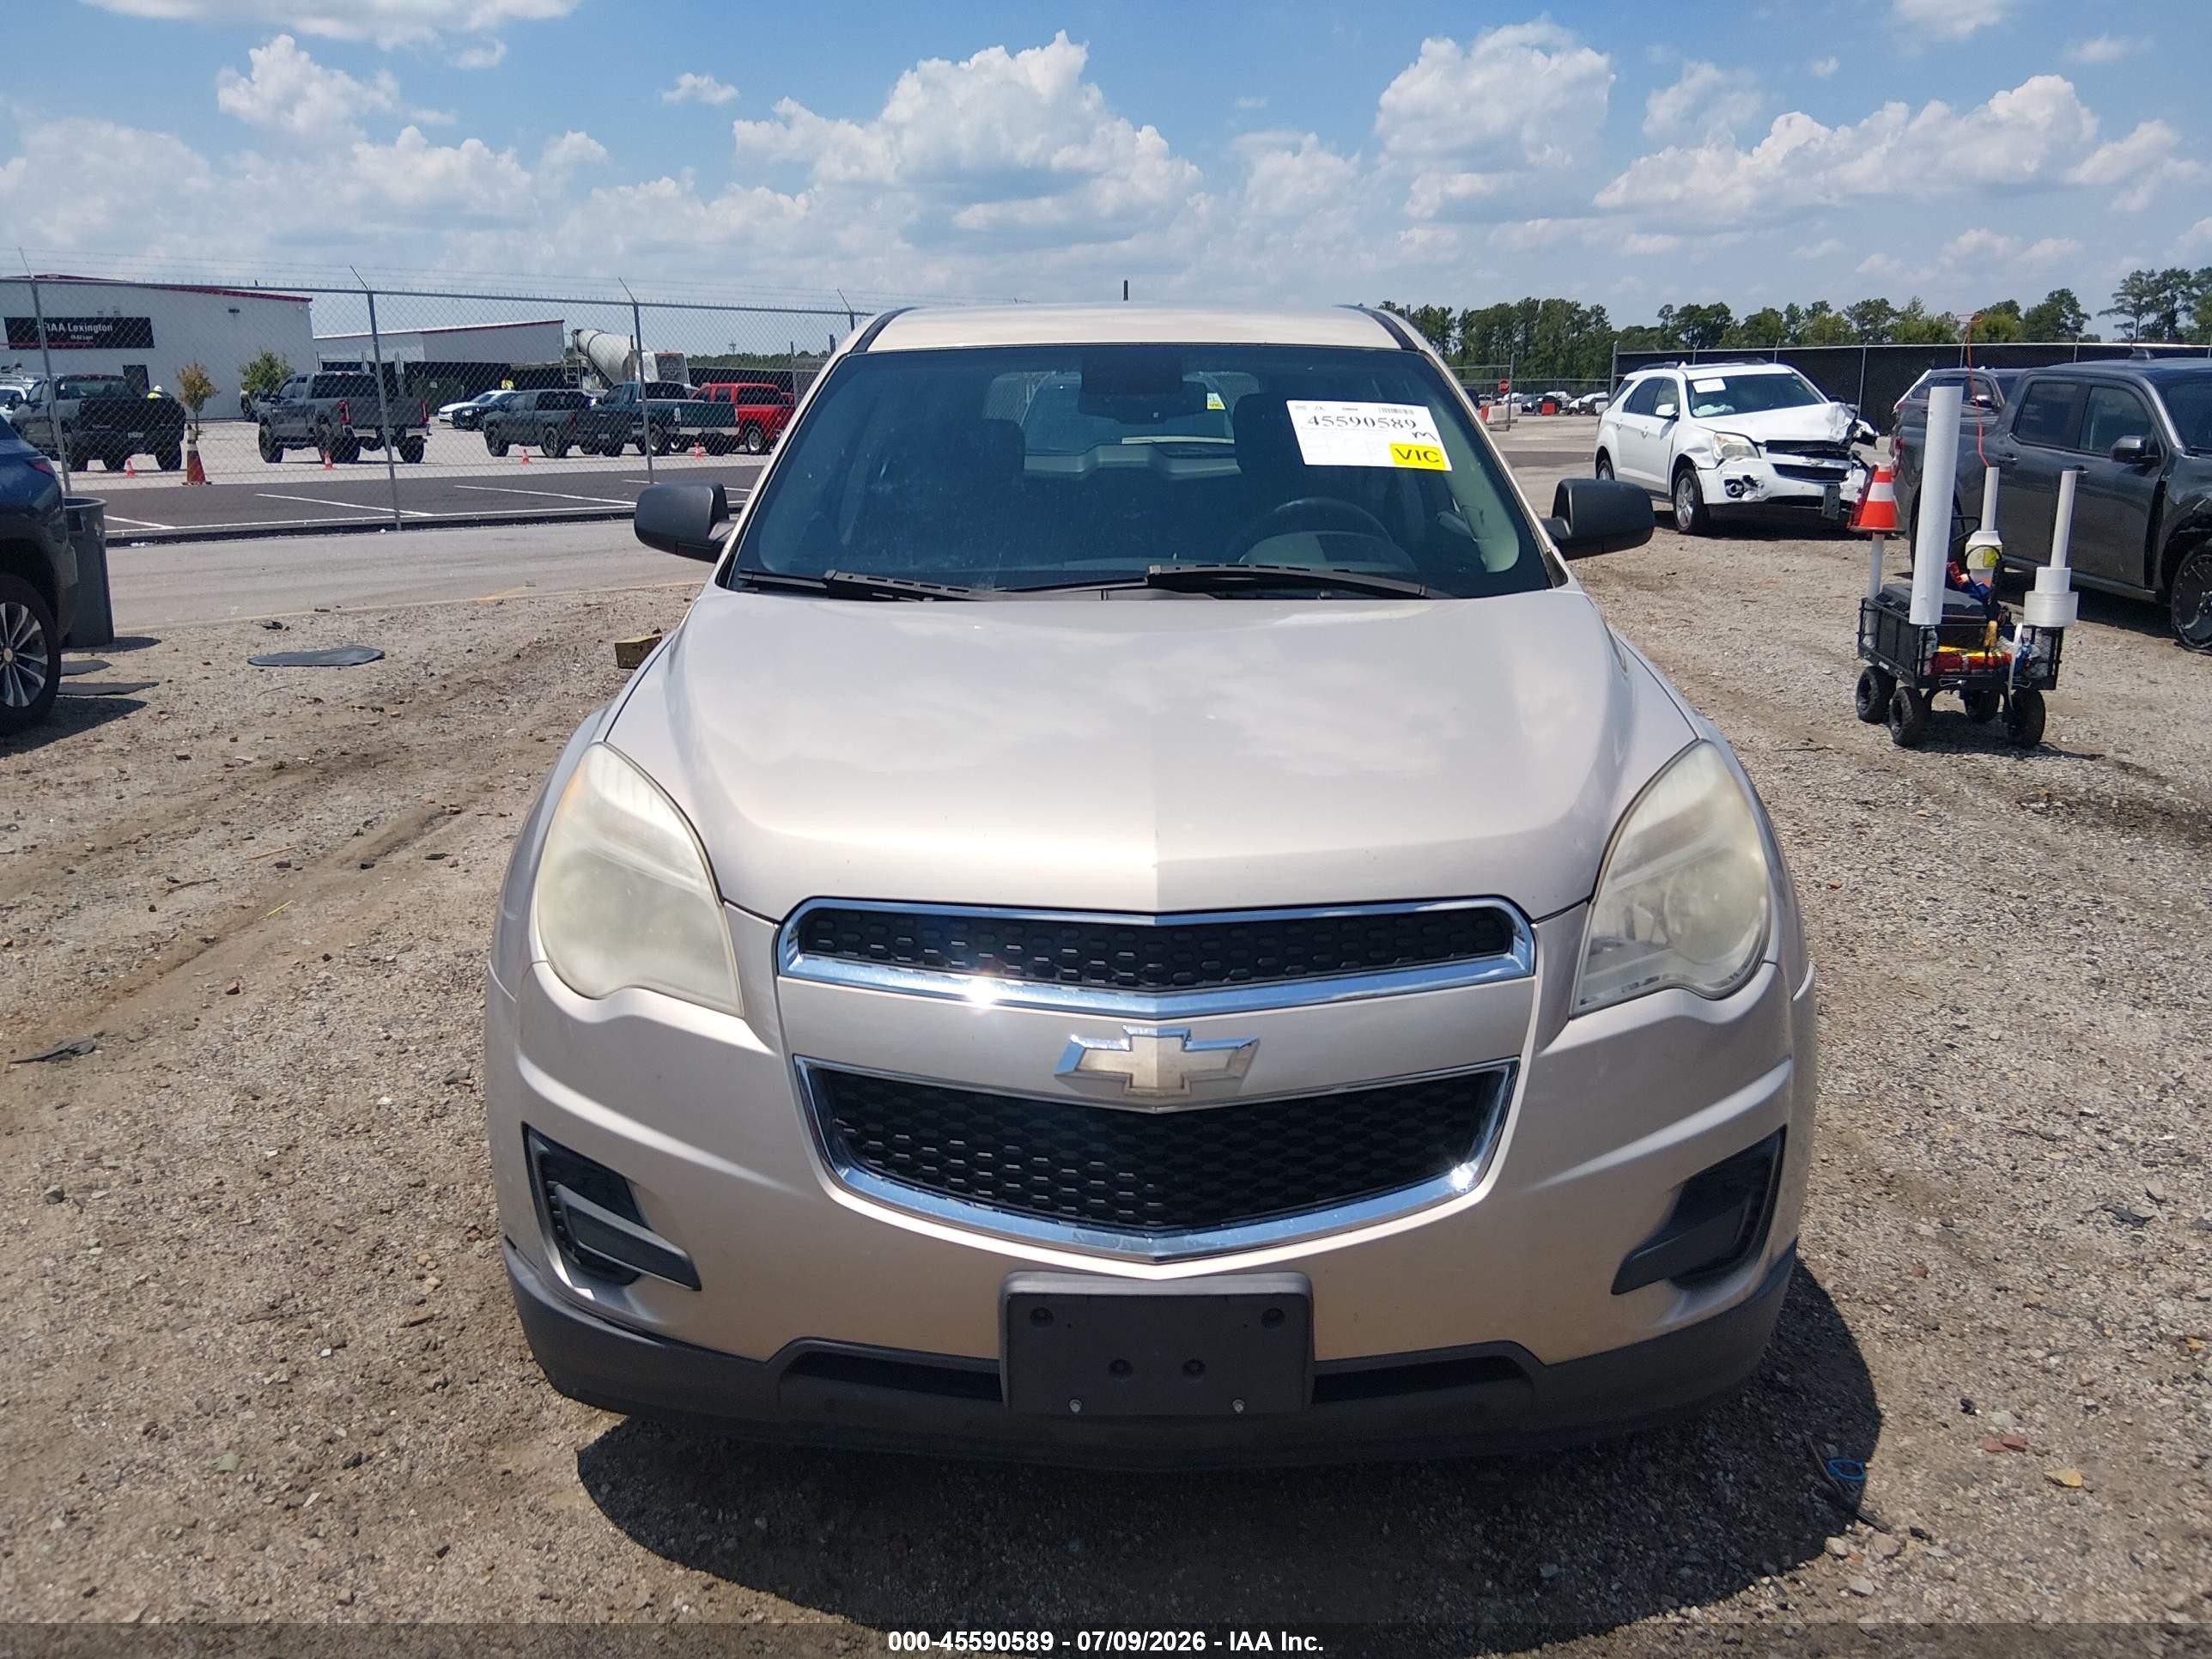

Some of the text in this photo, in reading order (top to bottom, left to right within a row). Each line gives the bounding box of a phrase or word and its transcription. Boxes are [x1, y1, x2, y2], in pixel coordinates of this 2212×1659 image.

[48, 323, 113, 333] IAA Lexington
[1308, 415, 1417, 428] 45590589
[1395, 447, 1440, 463] VIC
